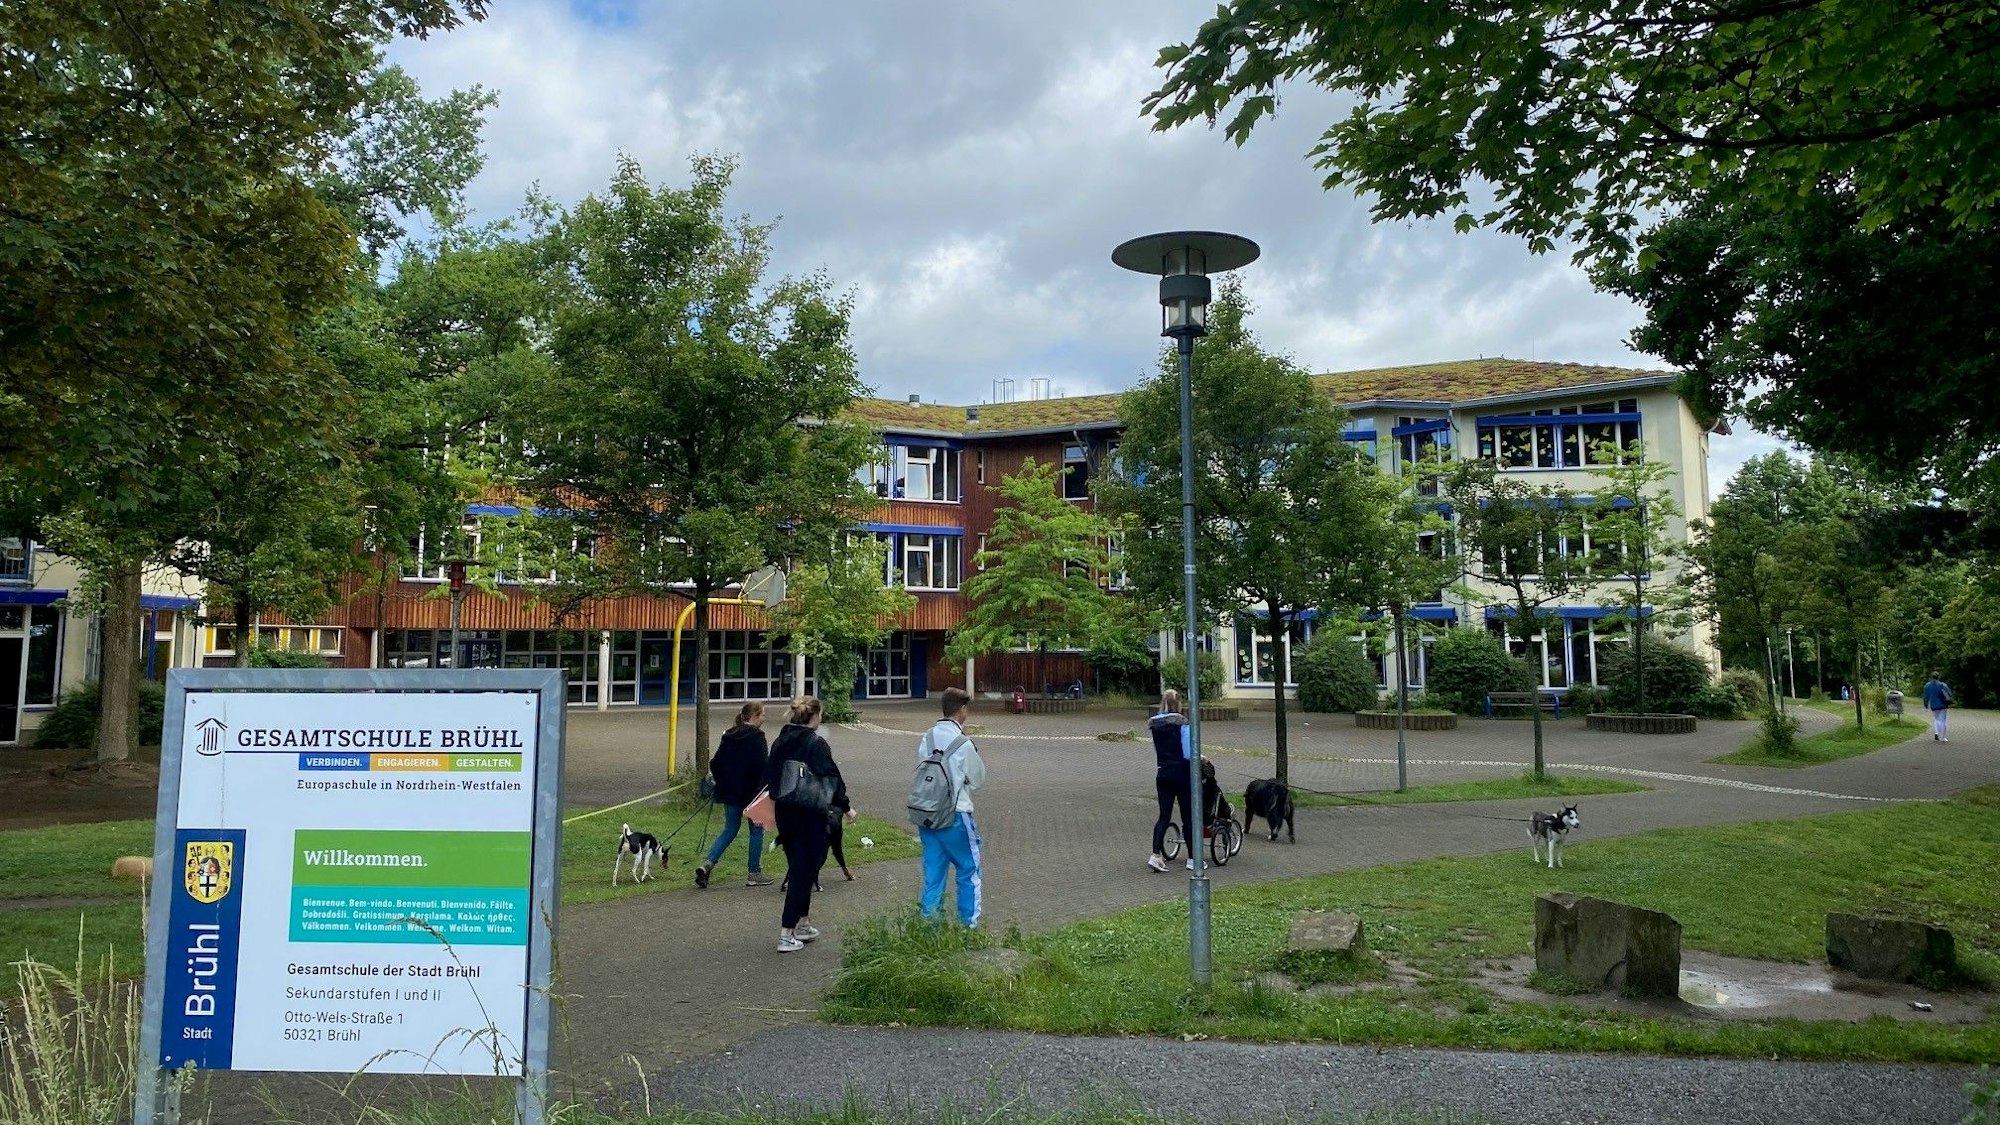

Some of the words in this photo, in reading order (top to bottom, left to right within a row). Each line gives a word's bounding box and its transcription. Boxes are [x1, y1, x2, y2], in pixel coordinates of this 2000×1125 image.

[238, 729, 432, 748] GESAMTSCHULE
[440, 726, 523, 748] BRÜHL
[306, 758, 363, 767] VERBINDEN.
[377, 758, 441, 768] ENGAGIEREN.
[456, 758, 514, 768] GESTALTEN.
[297, 780, 377, 792] Europaschule
[380, 780, 392, 790] in
[396, 780, 521, 791] Nordrhein-Westfalen
[303, 849, 429, 868] Willkommen.
[303, 898, 348, 907] Bienvenue.
[349, 899, 395, 908] Bem-vindo.
[396, 900, 440, 909] Benvenuti.
[441, 900, 489, 910] Bienvenido.
[490, 900, 516, 910] Fáilte.
[302, 910, 350, 919] Dobrodošli.
[302, 921, 352, 931] Välkommen.
[354, 922, 405, 931] Velkommen.
[449, 924, 484, 932] Welkom.
[486, 924, 516, 933] Witam.
[185, 924, 220, 1016] Brühl
[287, 963, 379, 976] Gesamtschule
[383, 965, 404, 977] der
[408, 965, 442, 977] Stadt
[446, 966, 480, 977] Brühl
[286, 987, 391, 1000] Sekundarstufen
[404, 990, 428, 1001] und
[284, 1011, 393, 1025] Otto-Wels-Straße
[398, 1013, 404, 1024] 1
[183, 1027, 213, 1040] Stadt
[284, 1029, 322, 1042] 50321
[327, 1029, 361, 1041] Brühl
